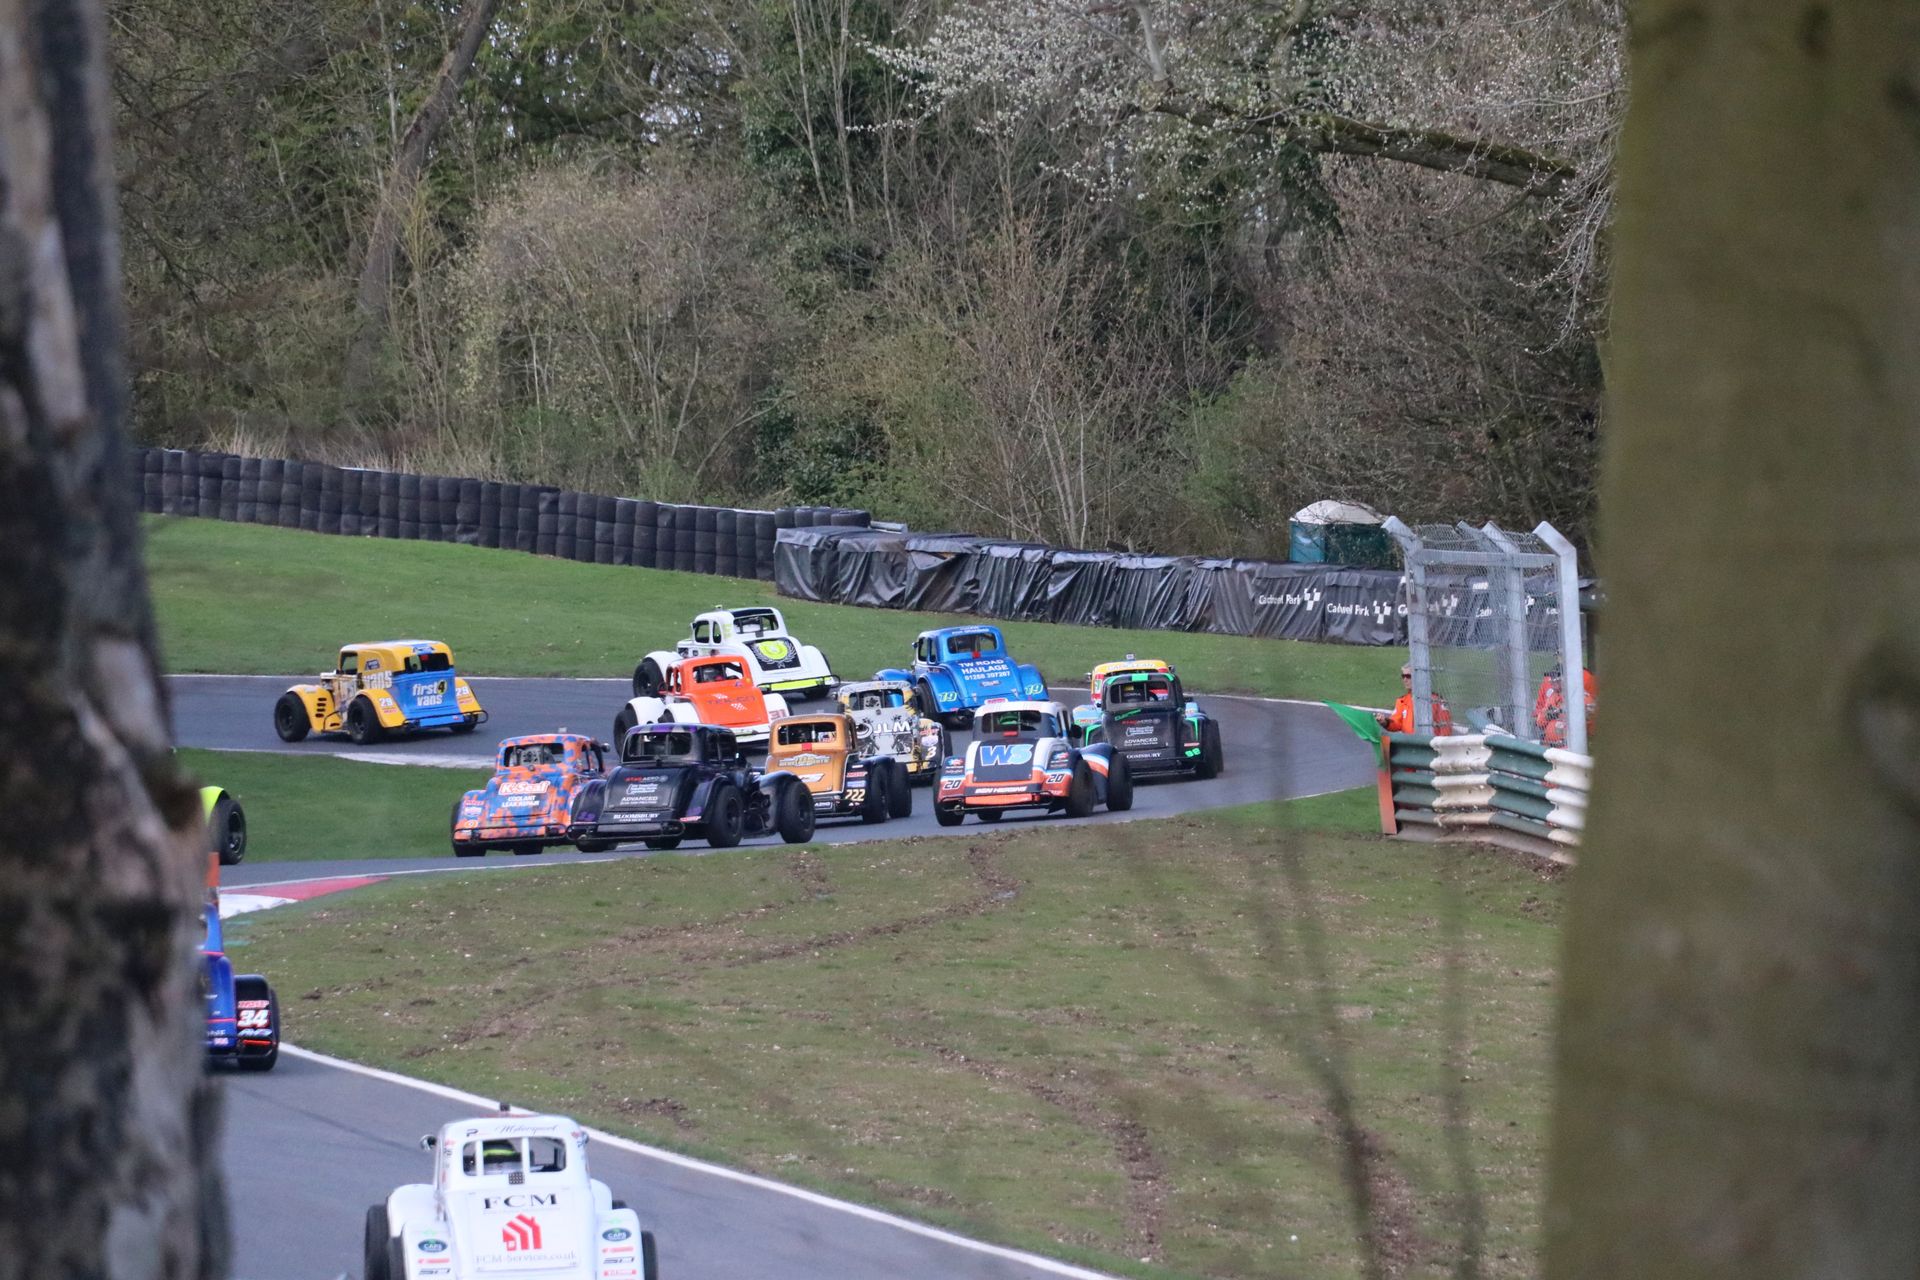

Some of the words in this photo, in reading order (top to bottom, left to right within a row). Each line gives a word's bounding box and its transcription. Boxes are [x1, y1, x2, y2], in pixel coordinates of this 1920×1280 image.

[975, 659, 1005, 667] ROAD
[961, 664, 1009, 675] HAULAGE
[455, 686, 470, 697] 29
[379, 697, 393, 708] 29
[416, 694, 443, 707] vans
[873, 721, 911, 734] JLM
[1046, 773, 1070, 783] 20
[944, 779, 962, 790] 20
[237, 1009, 270, 1028] 34
